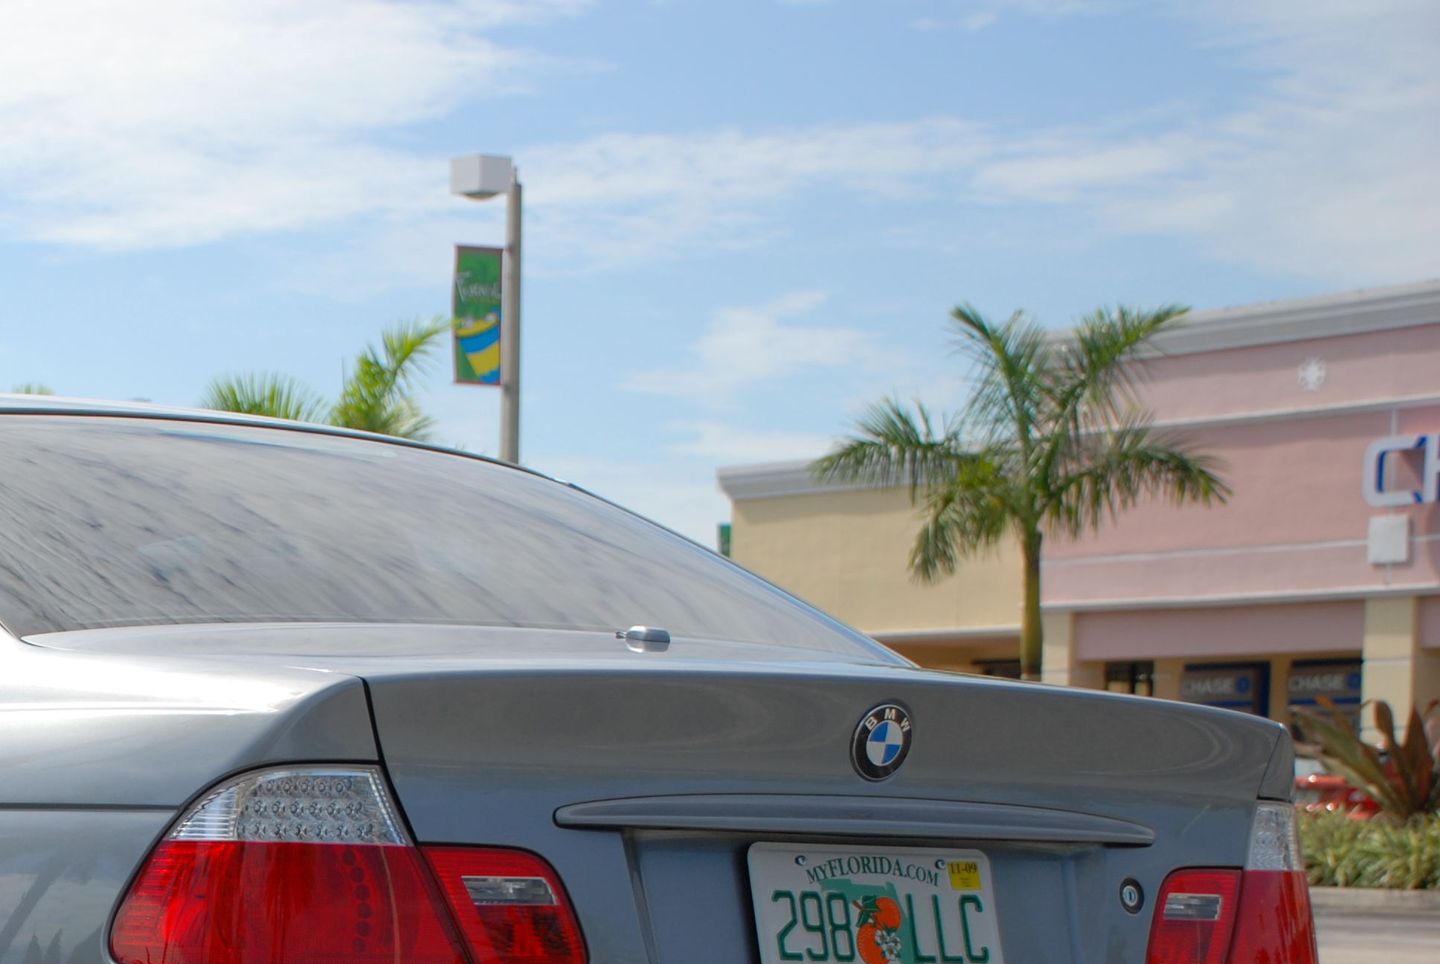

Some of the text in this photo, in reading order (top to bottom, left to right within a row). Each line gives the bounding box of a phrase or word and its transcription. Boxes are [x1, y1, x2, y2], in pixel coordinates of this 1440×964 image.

[1289, 672, 1346, 691] CHASE
[864, 708, 911, 732] BMW
[806, 855, 939, 887] MYFLORIDA.COM
[949, 862, 978, 874] 11-09
[771, 890, 990, 964] 298 LLC
